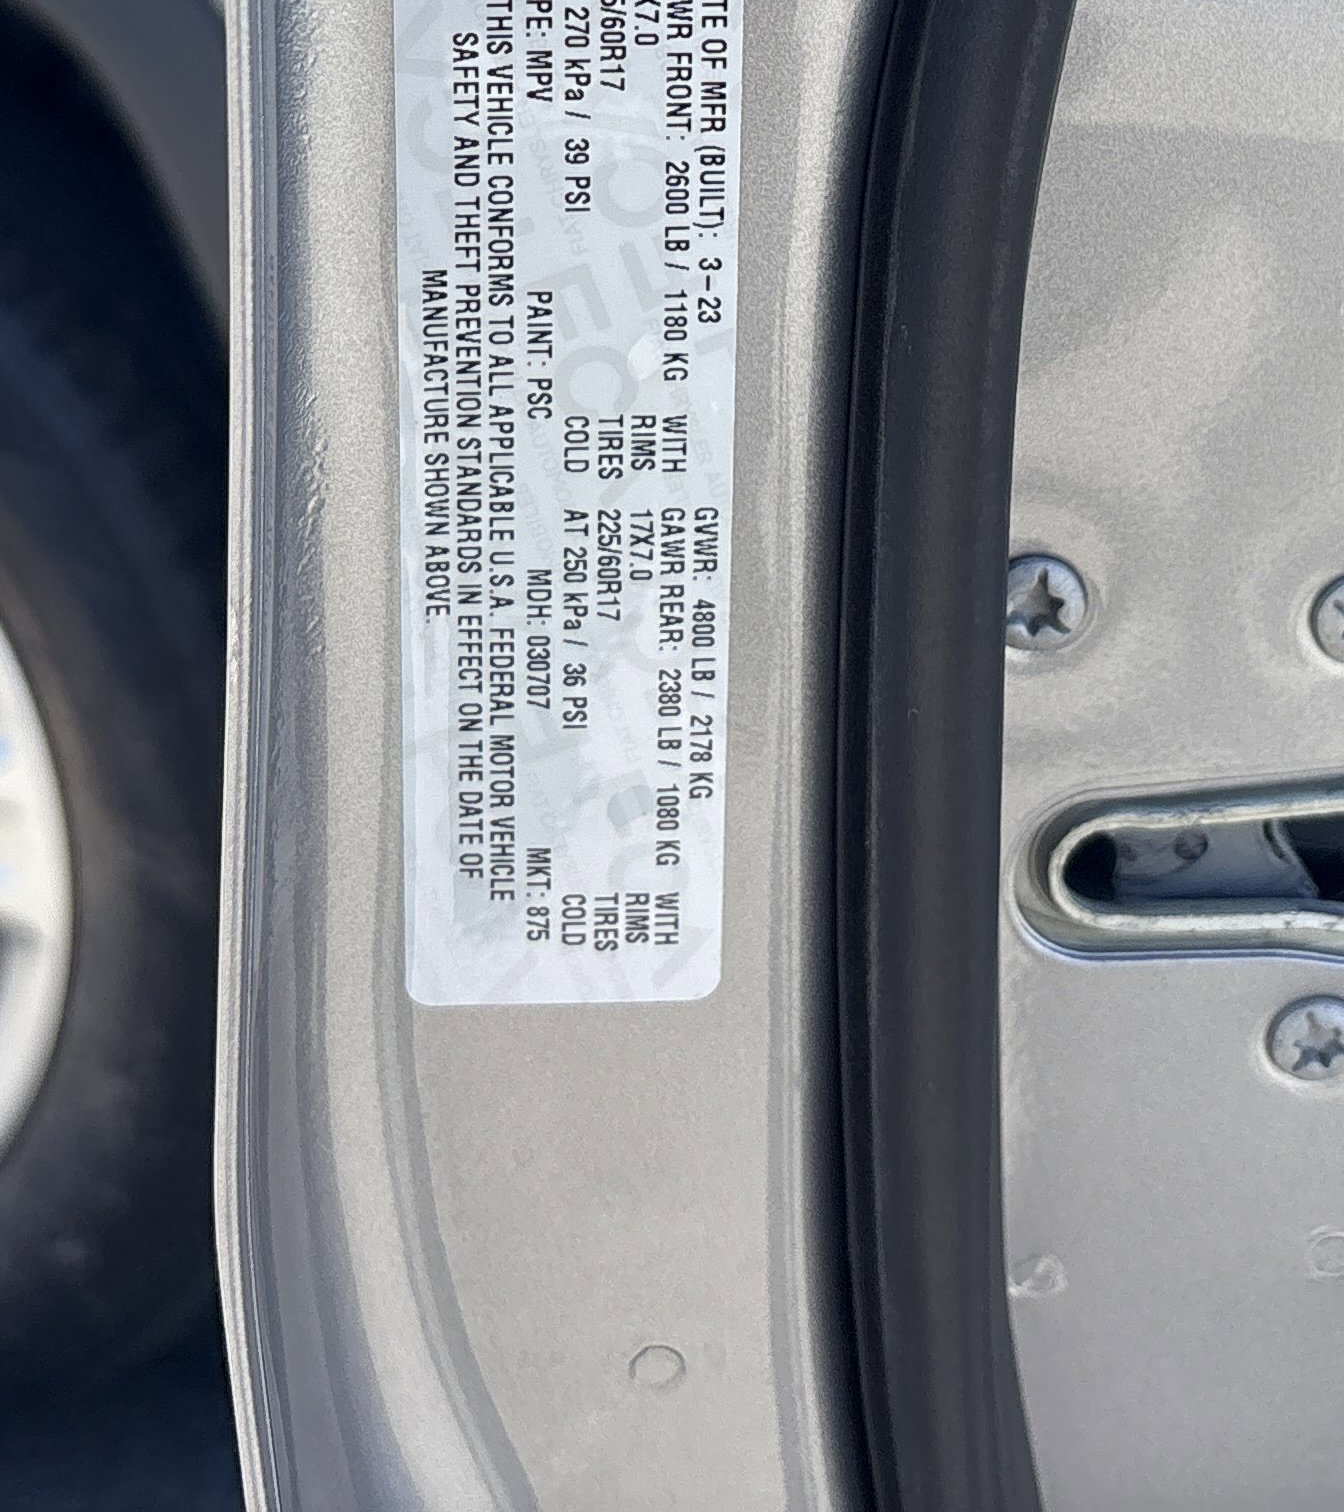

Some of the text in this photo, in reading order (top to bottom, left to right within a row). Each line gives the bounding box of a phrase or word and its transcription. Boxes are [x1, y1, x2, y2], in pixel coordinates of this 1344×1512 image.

[563, 5, 591, 49] 270
[700, 38, 728, 70] OF
[525, 49, 554, 103] MPV
[563, 58, 592, 102] kPa
[665, 51, 694, 141] FRONT:
[486, 63, 514, 166] VEHICLE
[699, 80, 728, 134] MFR
[564, 137, 590, 165] 39
[564, 175, 592, 213] PSI
[664, 160, 691, 215] 2600
[694, 144, 727, 238] (BUILT):
[487, 174, 515, 307] CONFORMS
[664, 225, 691, 252] LB
[487, 314, 515, 346] TO
[663, 288, 689, 342] 1180
[487, 353, 515, 397] ALL
[526, 290, 554, 420] PAINT: PSC
[661, 352, 690, 382] KG
[421, 269, 452, 625] MANUFACTURE SHOWN ABOVE.
[452, 32, 484, 880] SAFETY AND THEFT PREVENTION STANDARDS IN EFFECT ON THE DATE OF
[563, 415, 591, 474] COLD
[597, 413, 625, 481] TIRES
[629, 414, 657, 472] RIMS
[661, 413, 688, 473] WITH
[488, 403, 515, 542] APPLICABLE
[563, 508, 590, 538] AT
[659, 507, 687, 576] GAWR
[692, 506, 720, 582] GVWR:
[488, 550, 515, 618] U.S.A.
[562, 545, 588, 584] 250
[562, 591, 589, 631] kPa
[658, 583, 685, 652] REAR:
[690, 598, 717, 648] 4800
[525, 568, 553, 711] MDH: 030707
[488, 627, 516, 727] FEDERAL
[562, 662, 588, 688] 36
[657, 668, 683, 718] 2380
[690, 657, 717, 682] LB
[561, 696, 588, 730] PSI
[593, 508, 624, 952] 225/60R17 TIRES
[624, 508, 656, 944] 17X7.0 RIMS
[656, 726, 683, 751] LB
[689, 714, 714, 763] 2178
[488, 734, 516, 809] MOTOR
[688, 771, 714, 800] KG
[655, 782, 681, 832] 1080
[489, 815, 516, 902] VEHICLE
[655, 839, 681, 867] KG
[525, 847, 552, 942] MKT: 875
[560, 893, 587, 947] COLD
[653, 891, 680, 946] WITH
